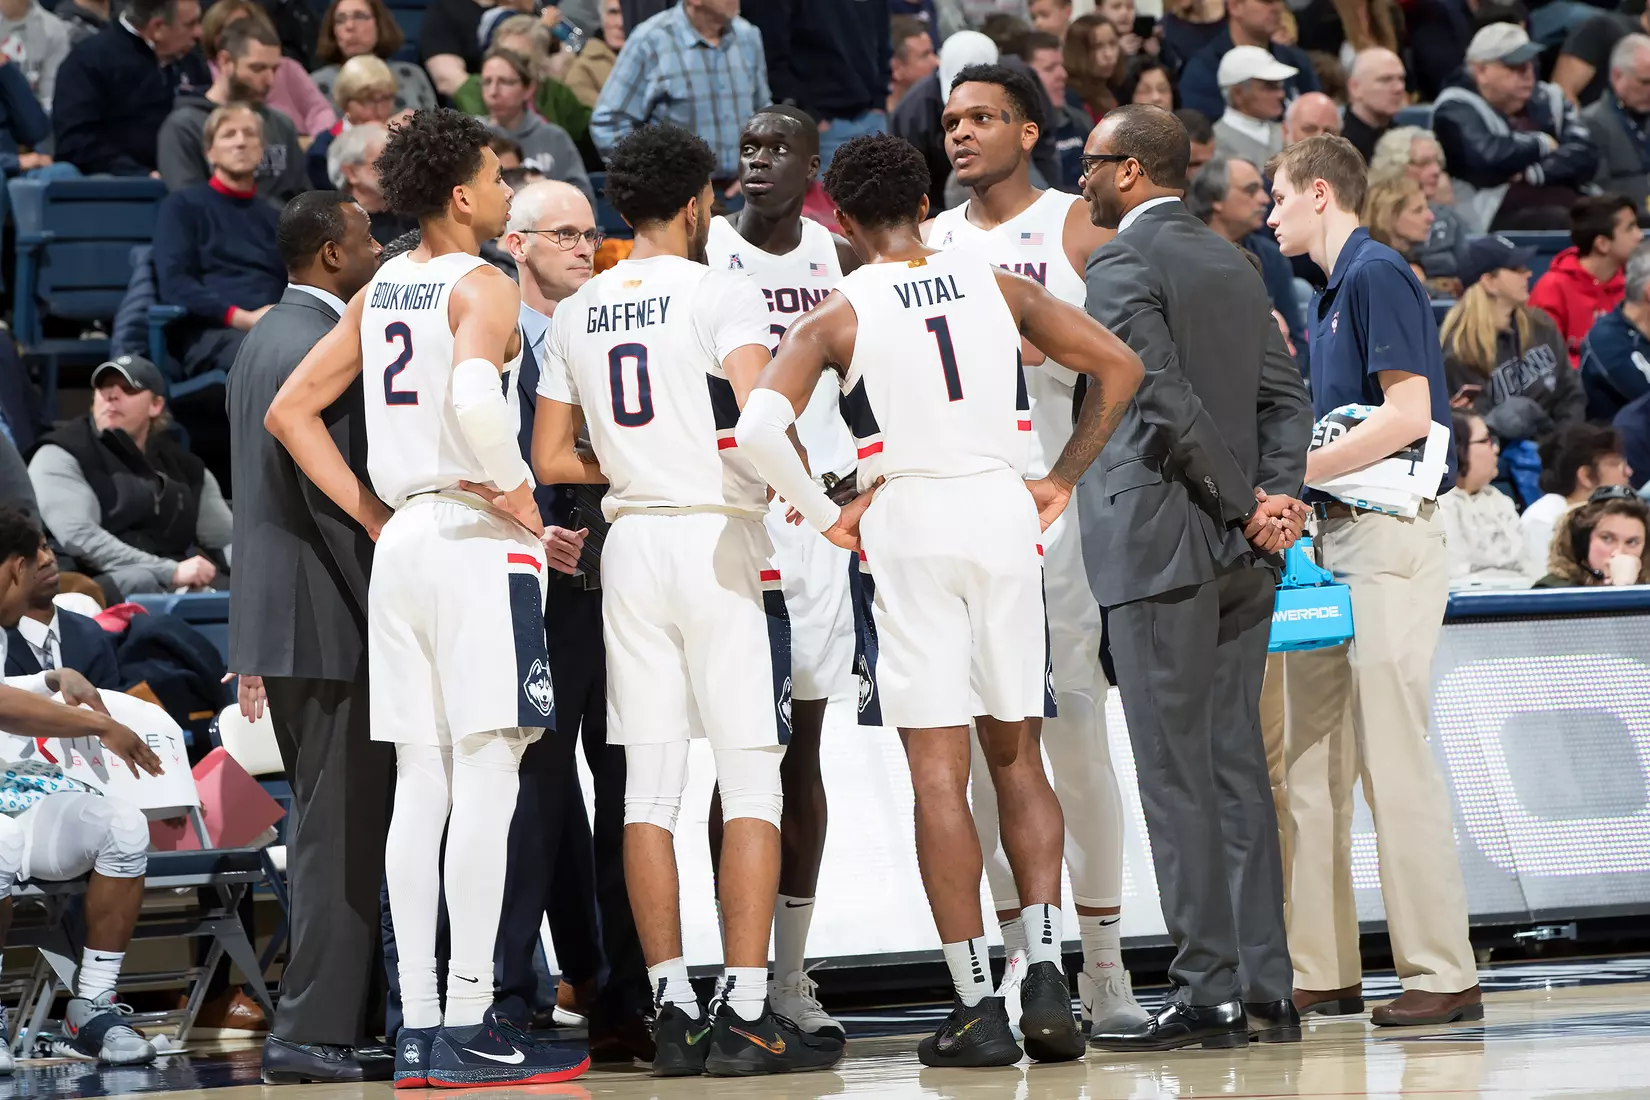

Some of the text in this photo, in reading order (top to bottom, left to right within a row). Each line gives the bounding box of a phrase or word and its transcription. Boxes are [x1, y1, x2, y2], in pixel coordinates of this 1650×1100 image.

[370, 282, 446, 310] BOUKNIGHT
[761, 287, 832, 314] ON
[893, 274, 966, 309] VITAL
[586, 295, 671, 334] GAFFNEY
[383, 321, 419, 406] 2
[924, 314, 965, 403] 1
[607, 342, 655, 428] 0
[1272, 605, 1340, 623] WERADE
[72, 754, 180, 768] GALY
